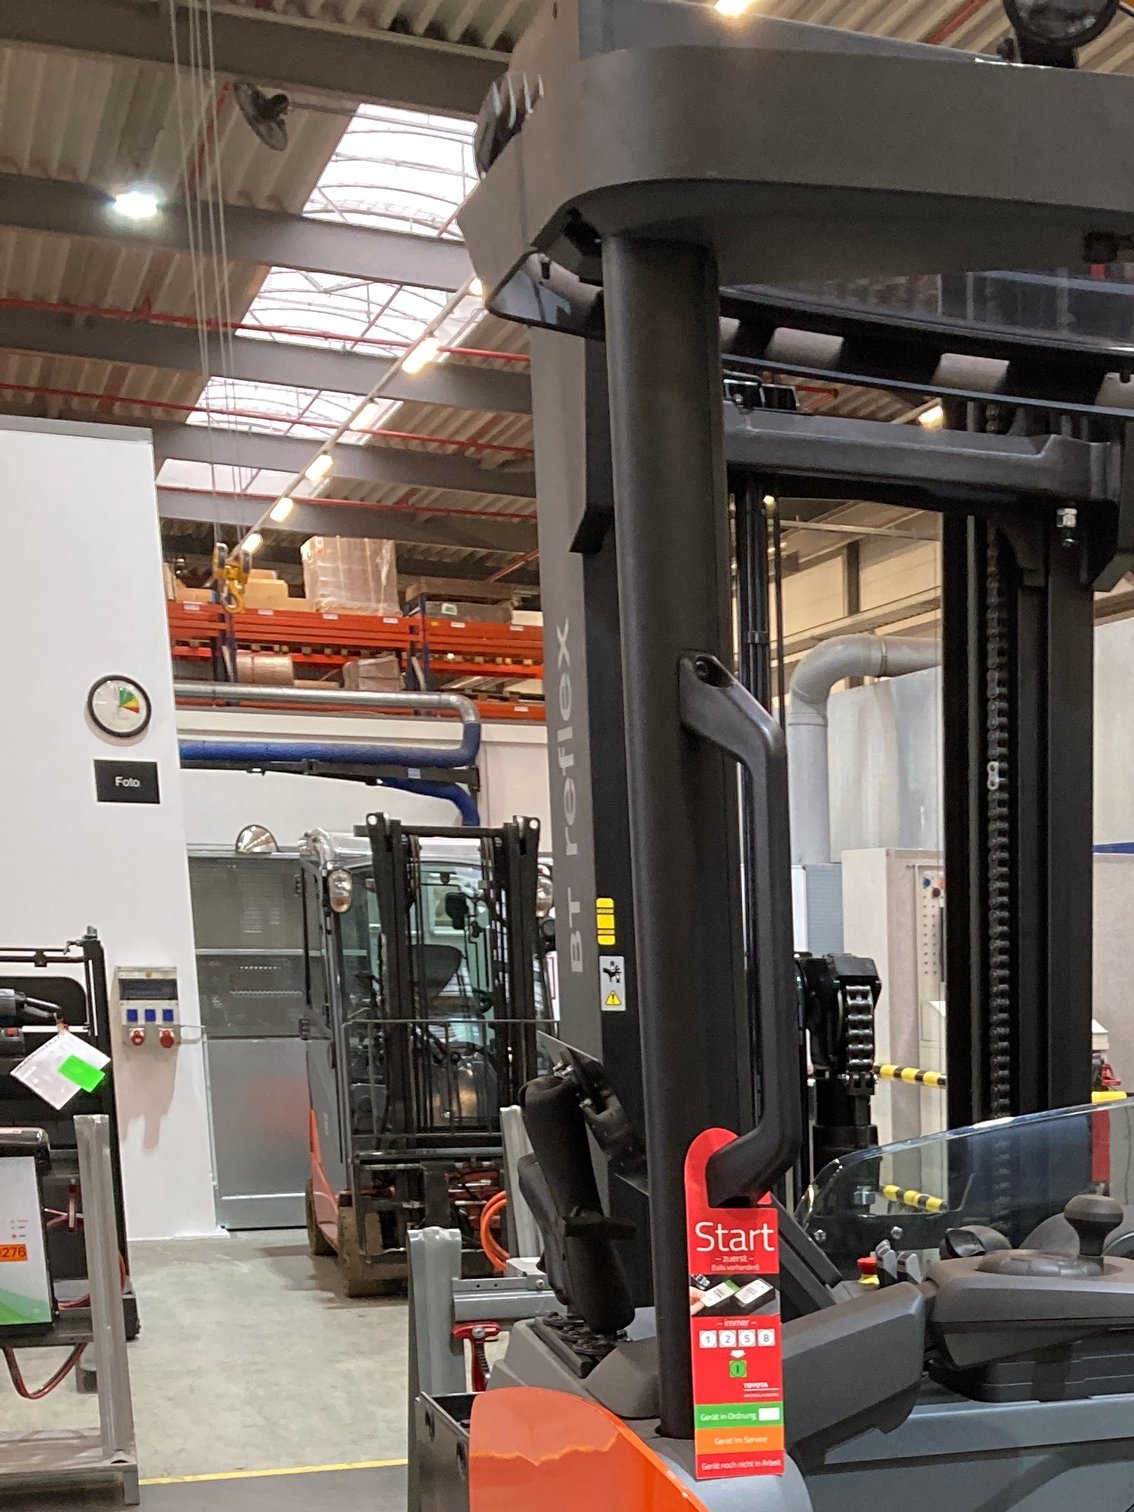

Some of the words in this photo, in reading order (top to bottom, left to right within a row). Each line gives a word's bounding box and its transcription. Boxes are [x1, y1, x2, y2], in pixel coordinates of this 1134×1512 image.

[556, 617, 578, 856] reflex
[114, 776, 141, 788] Foto
[568, 887, 584, 973] BT
[694, 1221, 776, 1252] Start
[0, 1246, 27, 1258] 276
[725, 1334, 731, 1344] 2
[744, 1334, 751, 1343] 5
[763, 1333, 770, 1343] 8
